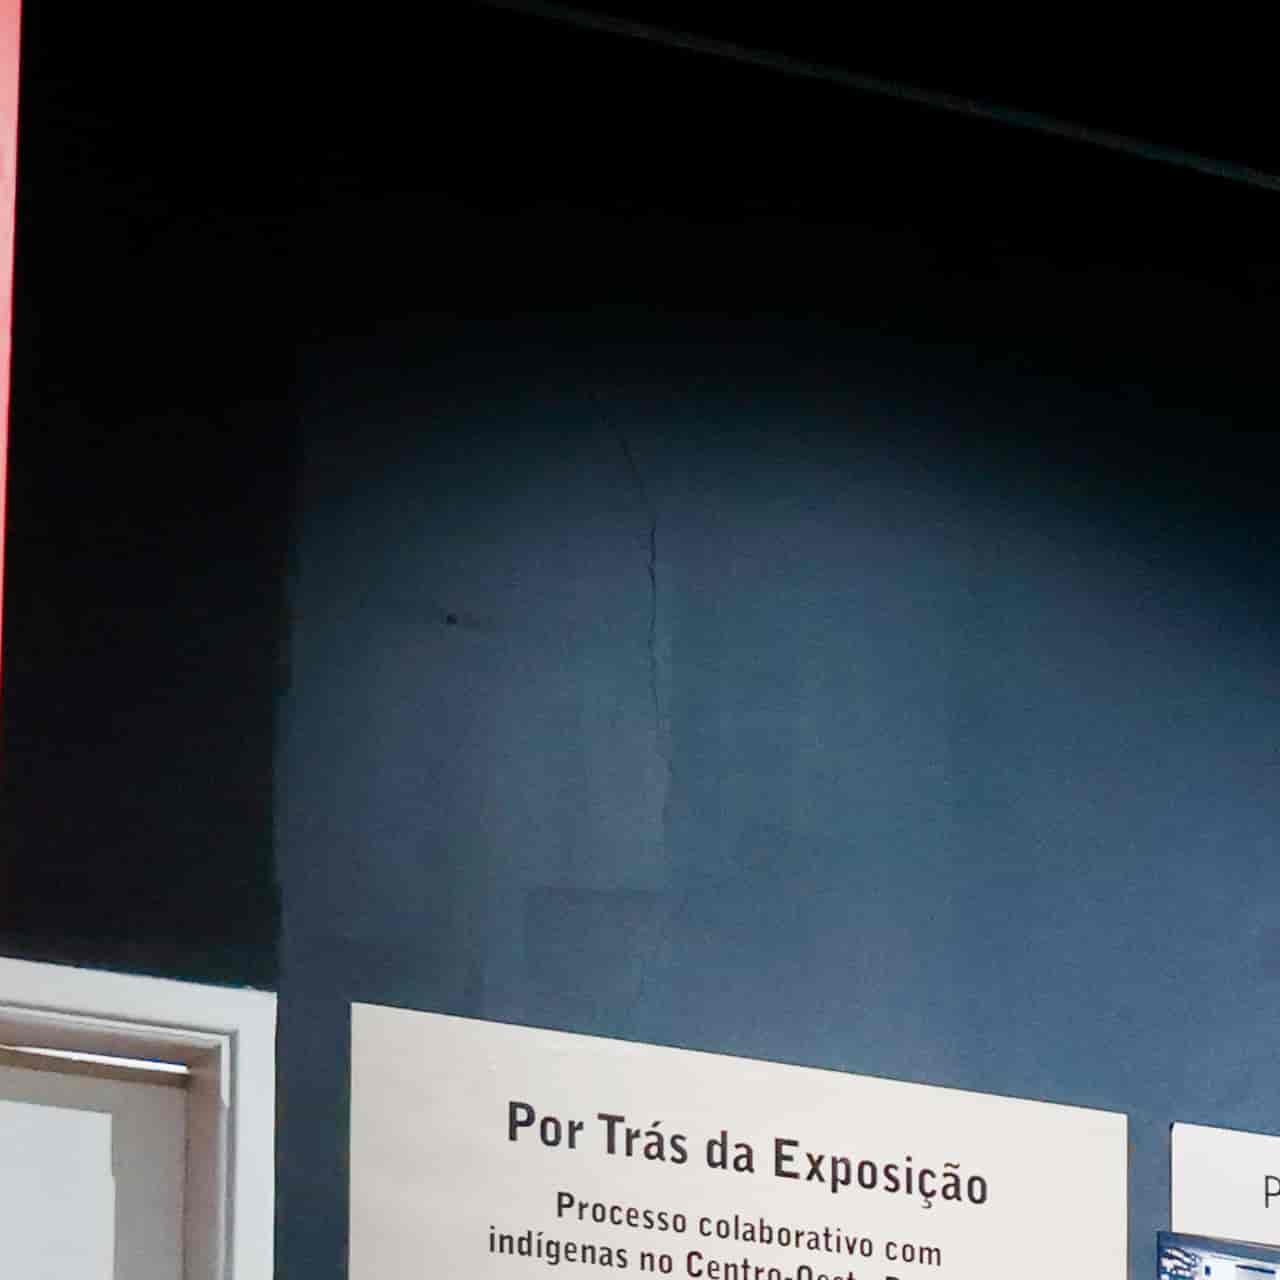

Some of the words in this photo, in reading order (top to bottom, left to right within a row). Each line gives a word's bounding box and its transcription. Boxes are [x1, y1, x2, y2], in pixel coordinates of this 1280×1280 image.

[506, 1099, 585, 1150] Por
[595, 1111, 689, 1165] Trás
[704, 1128, 756, 1175] da
[772, 1135, 988, 1210] Exposição
[488, 1223, 629, 1270] indígenas
[638, 1249, 673, 1275] no
[555, 1190, 687, 1234] Processo
[698, 1212, 874, 1259] colaborativo
[884, 1239, 942, 1268] com
